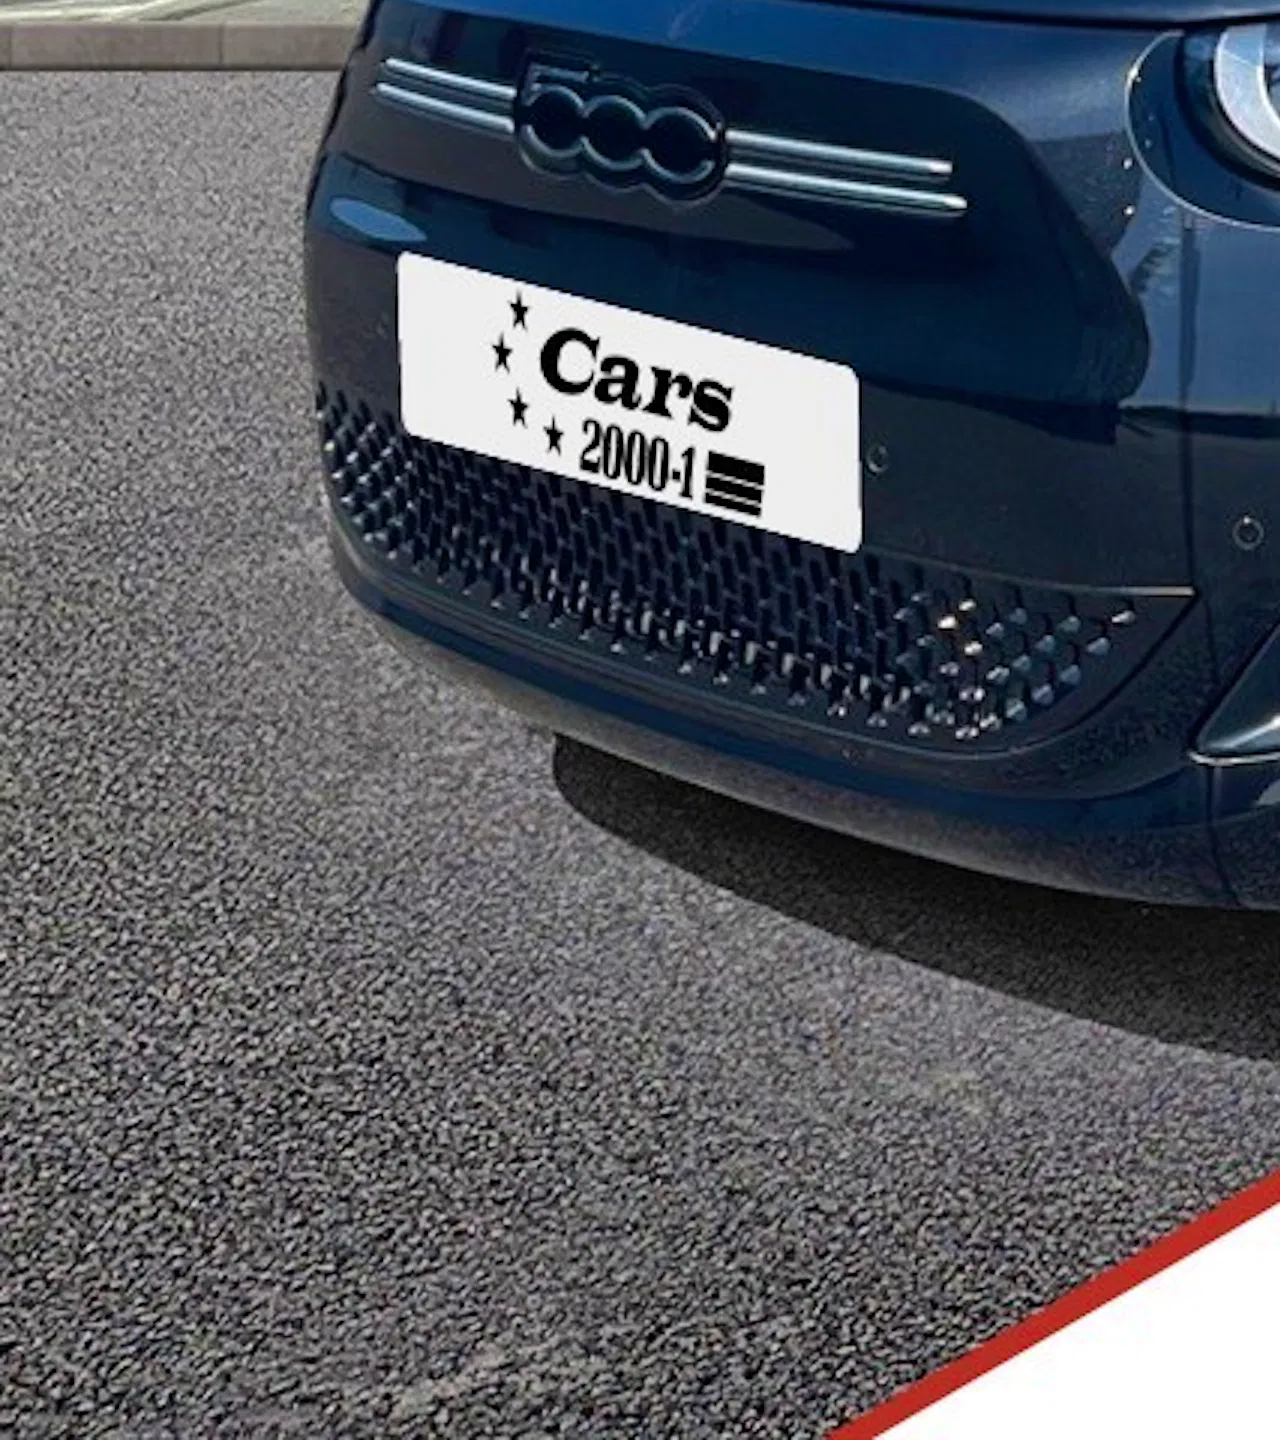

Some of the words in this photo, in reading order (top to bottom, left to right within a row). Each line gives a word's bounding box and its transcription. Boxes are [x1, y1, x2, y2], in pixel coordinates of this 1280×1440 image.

[519, 60, 722, 192] 500
[539, 326, 735, 434] Cars
[579, 418, 697, 500] 2000-1
